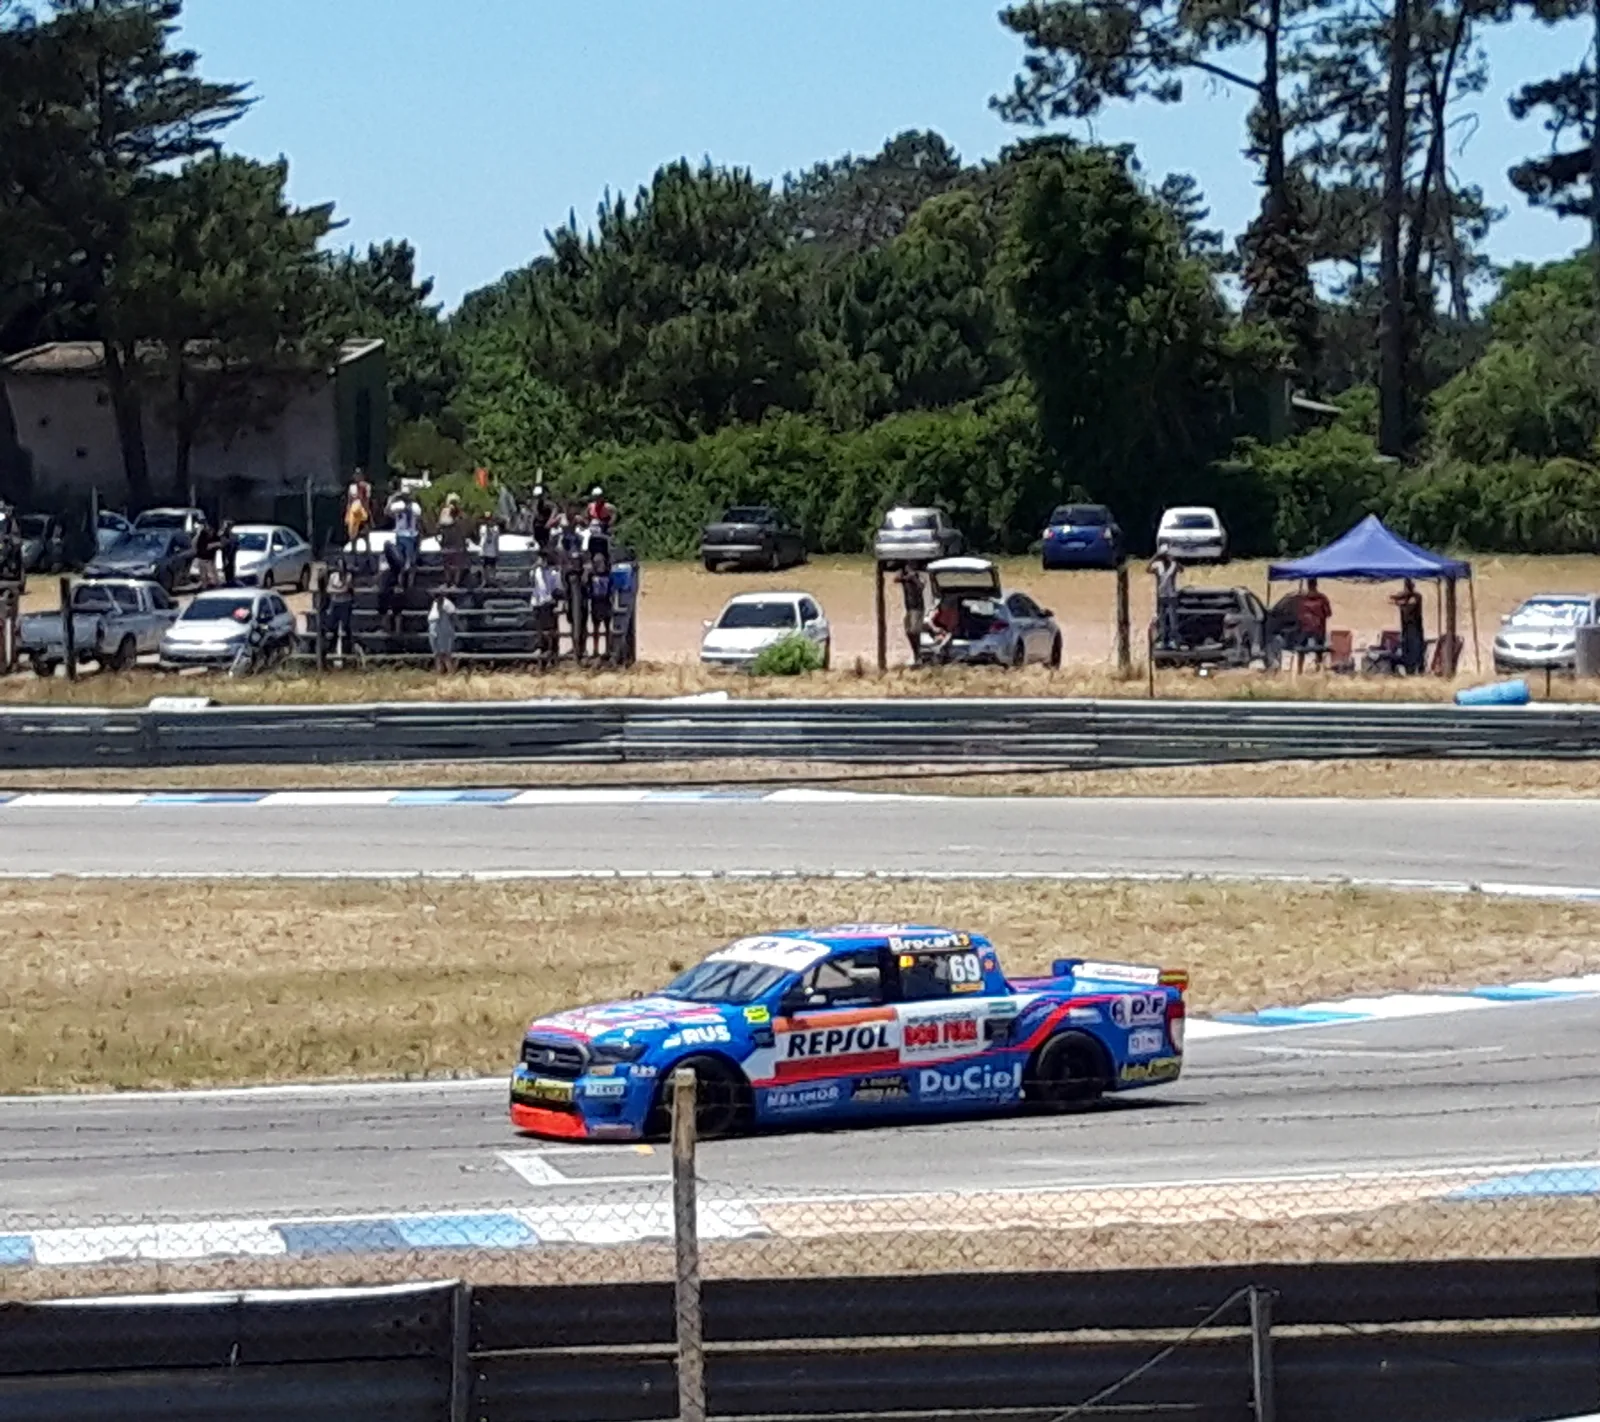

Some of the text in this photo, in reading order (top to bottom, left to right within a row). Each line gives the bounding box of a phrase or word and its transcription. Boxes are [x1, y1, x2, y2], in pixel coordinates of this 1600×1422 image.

[949, 954, 981, 982] 69
[787, 1025, 889, 1058] REPSOL
[920, 1062, 1022, 1092] DuCiol
